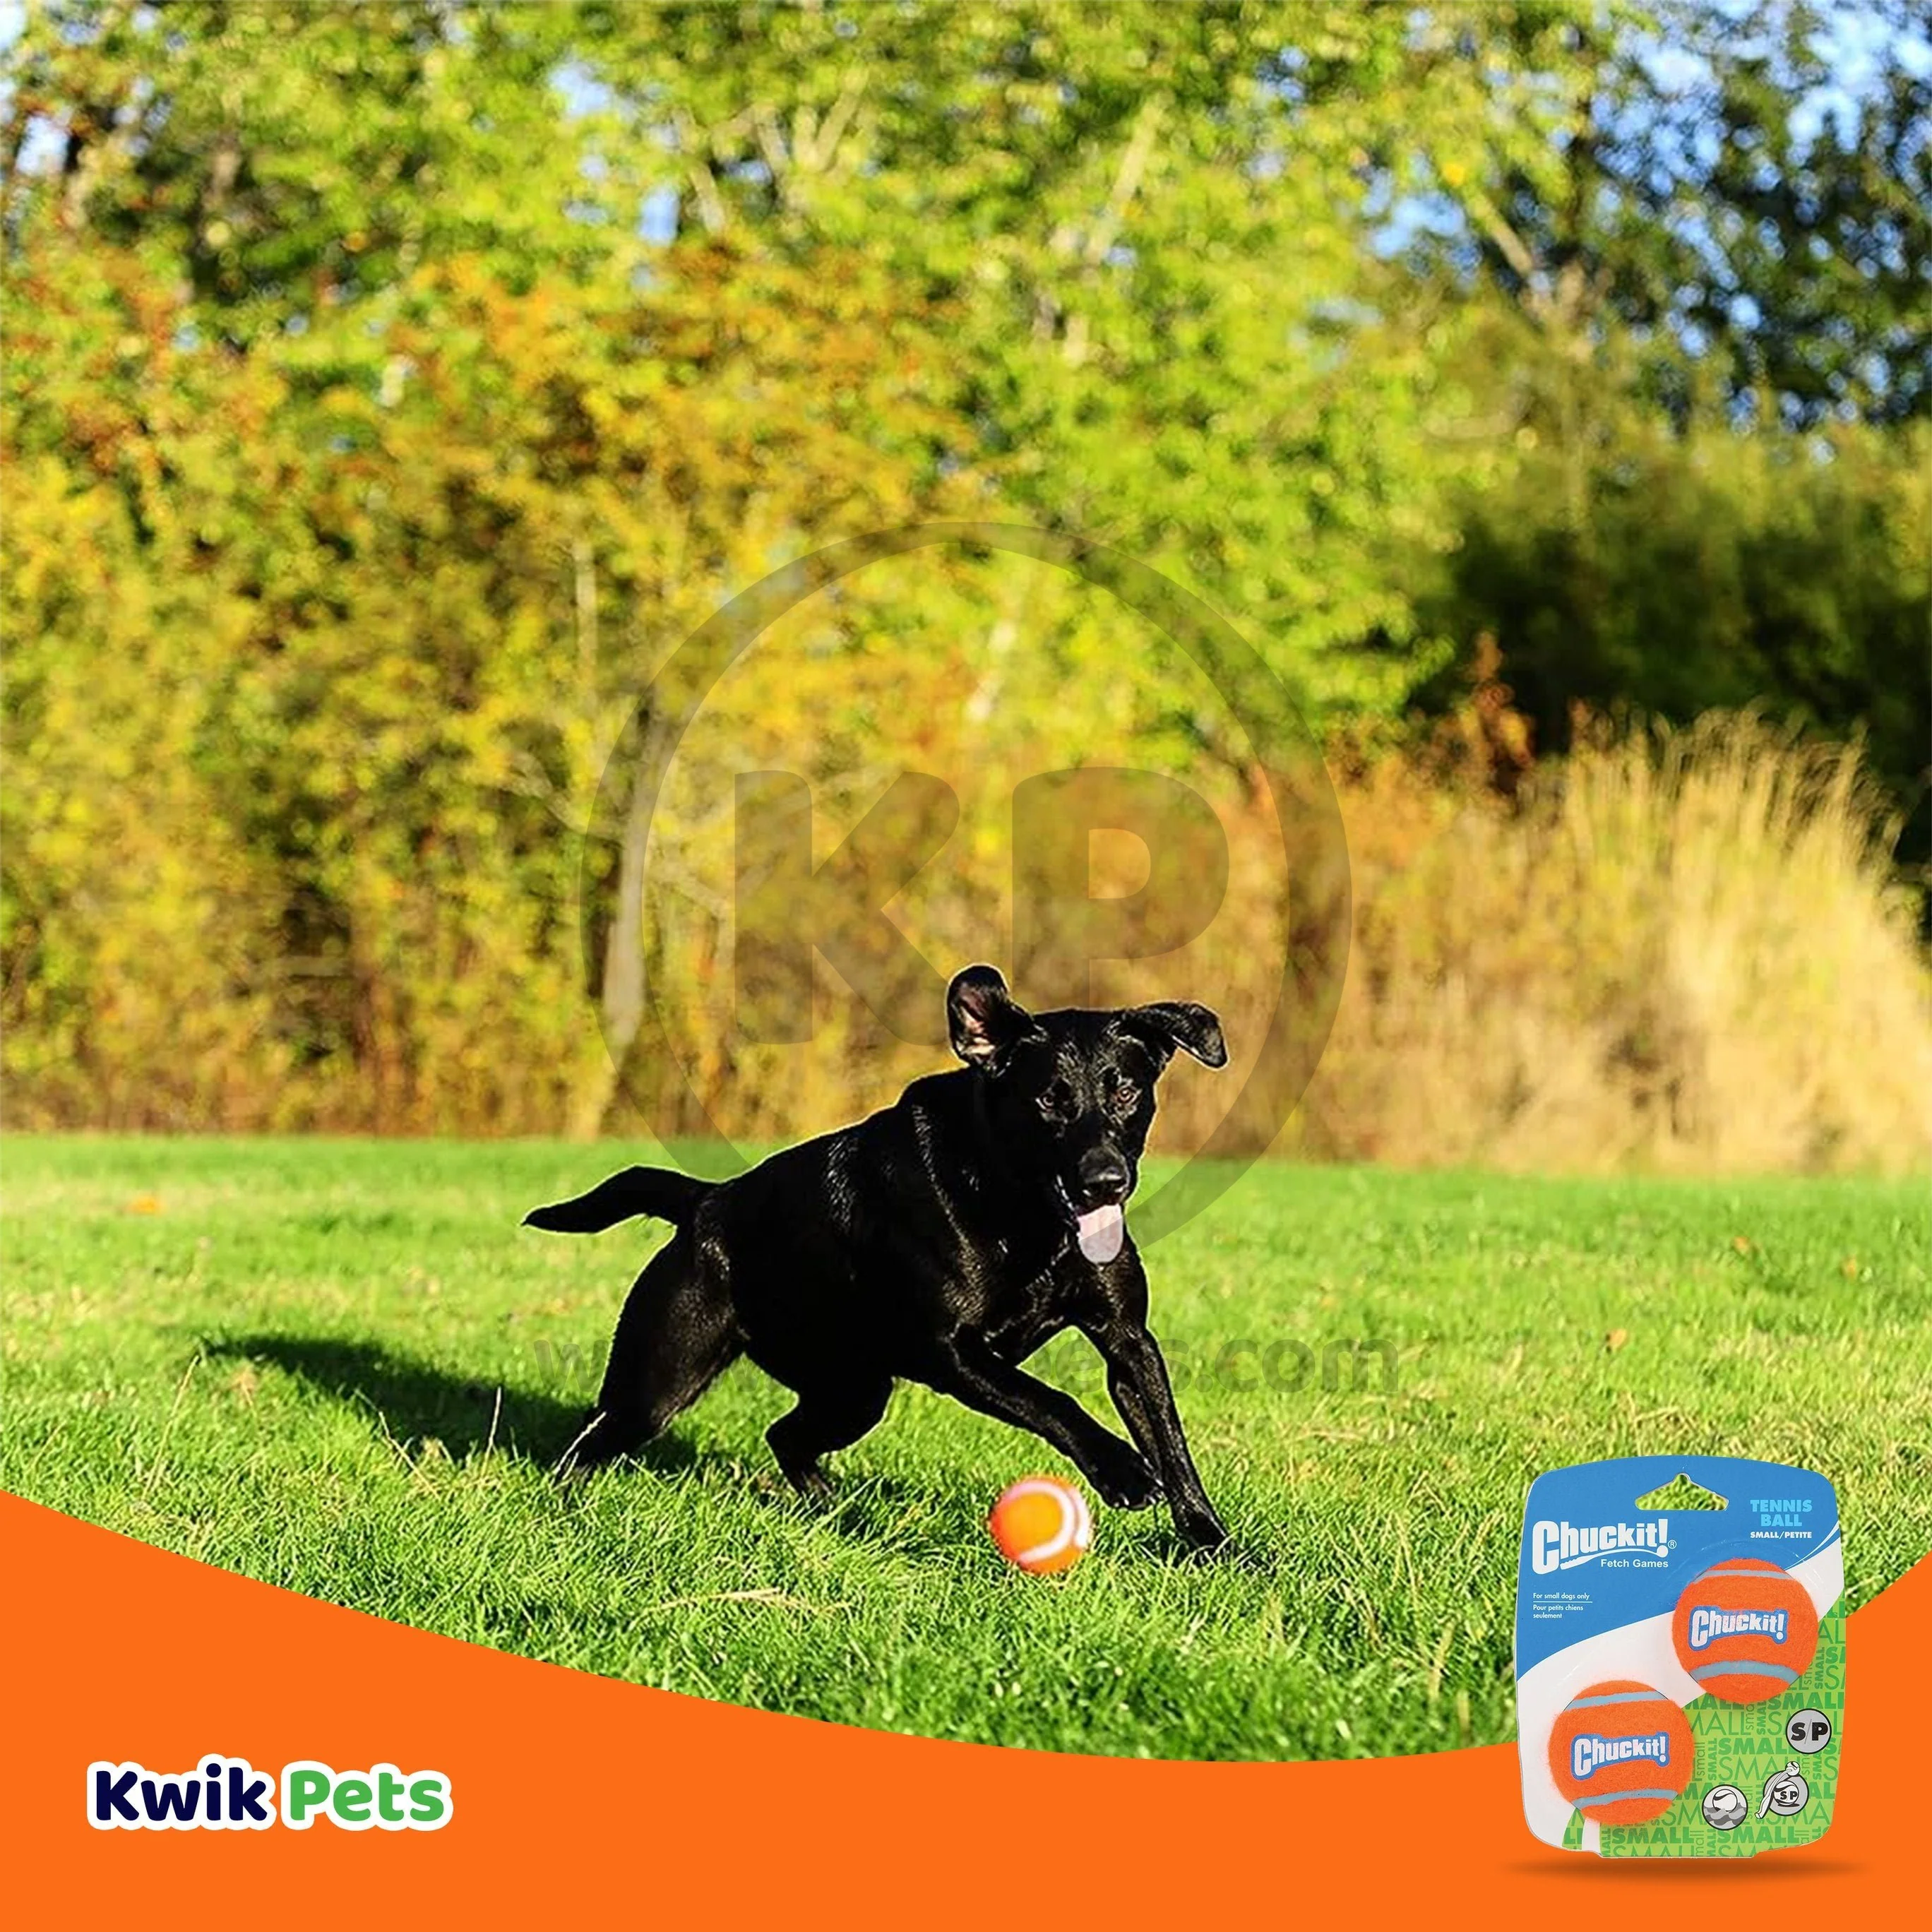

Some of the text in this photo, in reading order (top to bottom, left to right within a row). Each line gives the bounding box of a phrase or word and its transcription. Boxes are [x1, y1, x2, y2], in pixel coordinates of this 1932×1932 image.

[1750, 1499, 1813, 1512] TENNIS
[1760, 1513, 1803, 1527] BALL
[1750, 1531, 1813, 1539] SMALL/PETITE
[1600, 1558, 1669, 1568] Fetch Games
[1561, 1592, 1575, 1601] dogs
[1576, 1592, 1590, 1601] only
[1691, 1610, 1784, 1647] Chuckit!
[1814, 1647, 1825, 1690] SMALL
[1574, 1736, 1666, 1776] Chuckit!
[1611, 1827, 1695, 1844] SMALL
[1717, 1826, 1800, 1844] SMALL
